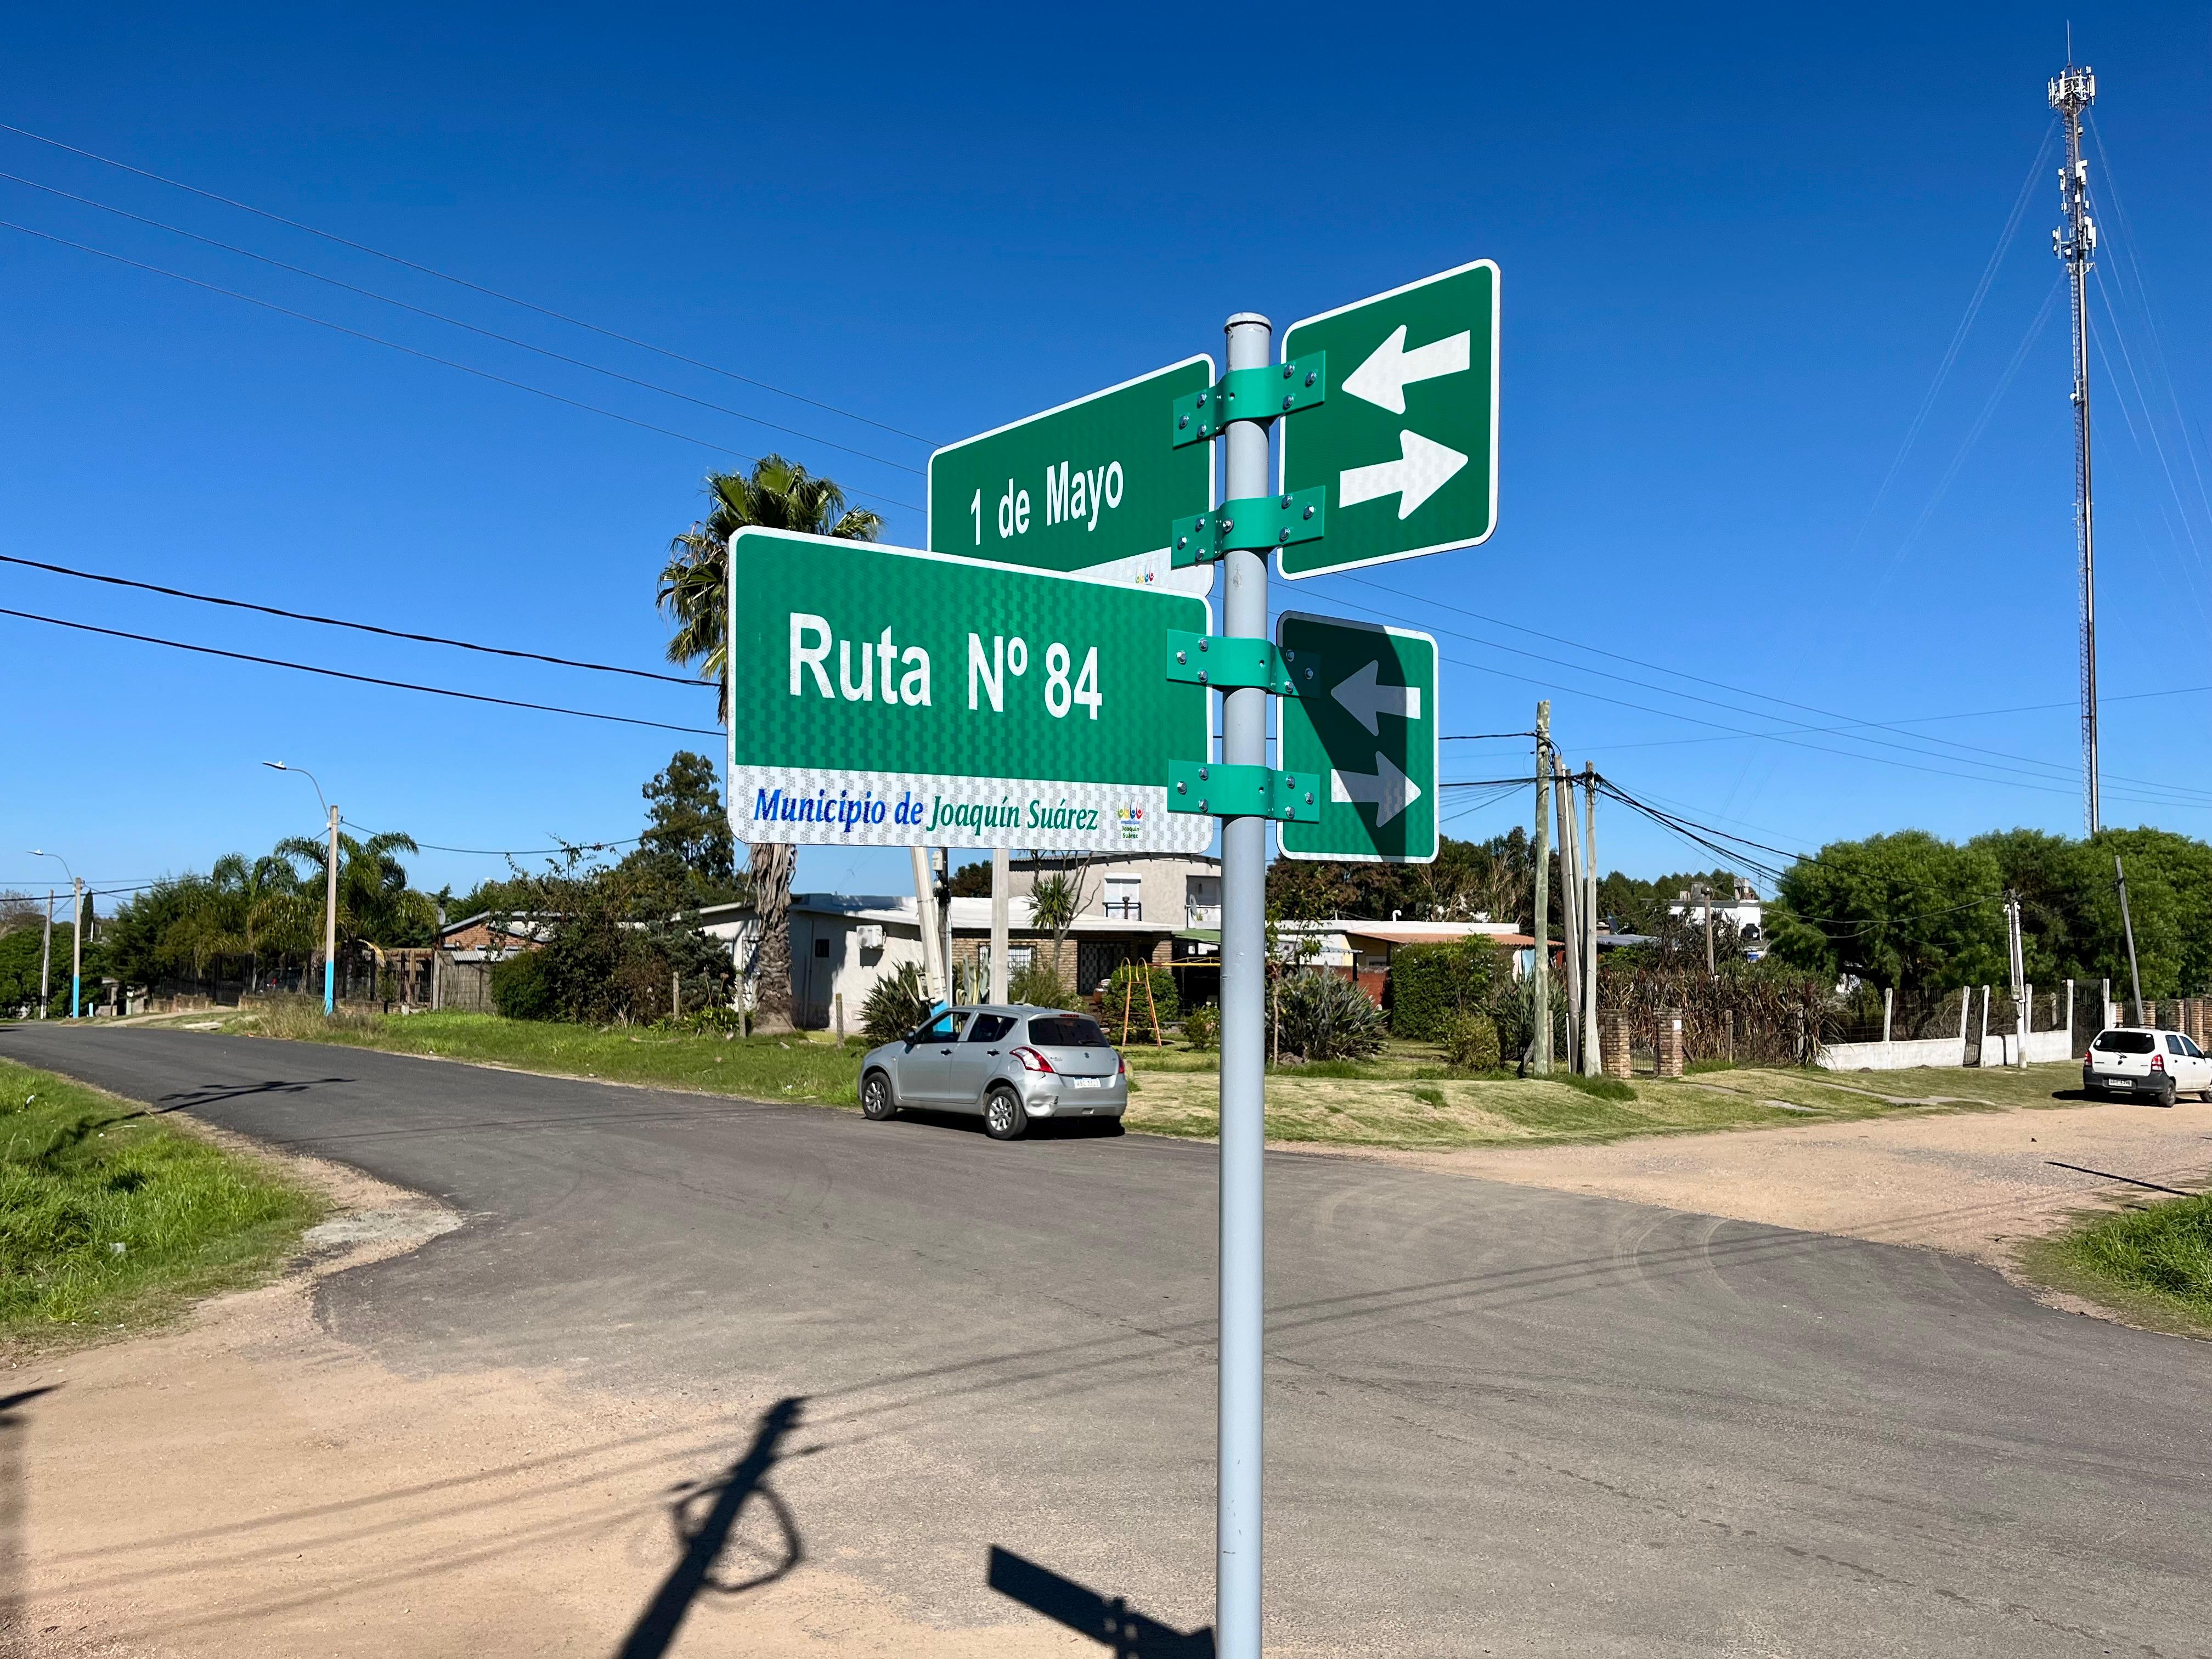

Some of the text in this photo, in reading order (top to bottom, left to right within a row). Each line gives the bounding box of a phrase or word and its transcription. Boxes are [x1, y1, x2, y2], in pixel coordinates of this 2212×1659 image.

[970, 460, 1124, 546] 1 de Mayo
[789, 612, 932, 707] Ruta
[1044, 642, 1103, 720] 84
[753, 788, 1098, 836] Municipio de Joaquín Suárez
